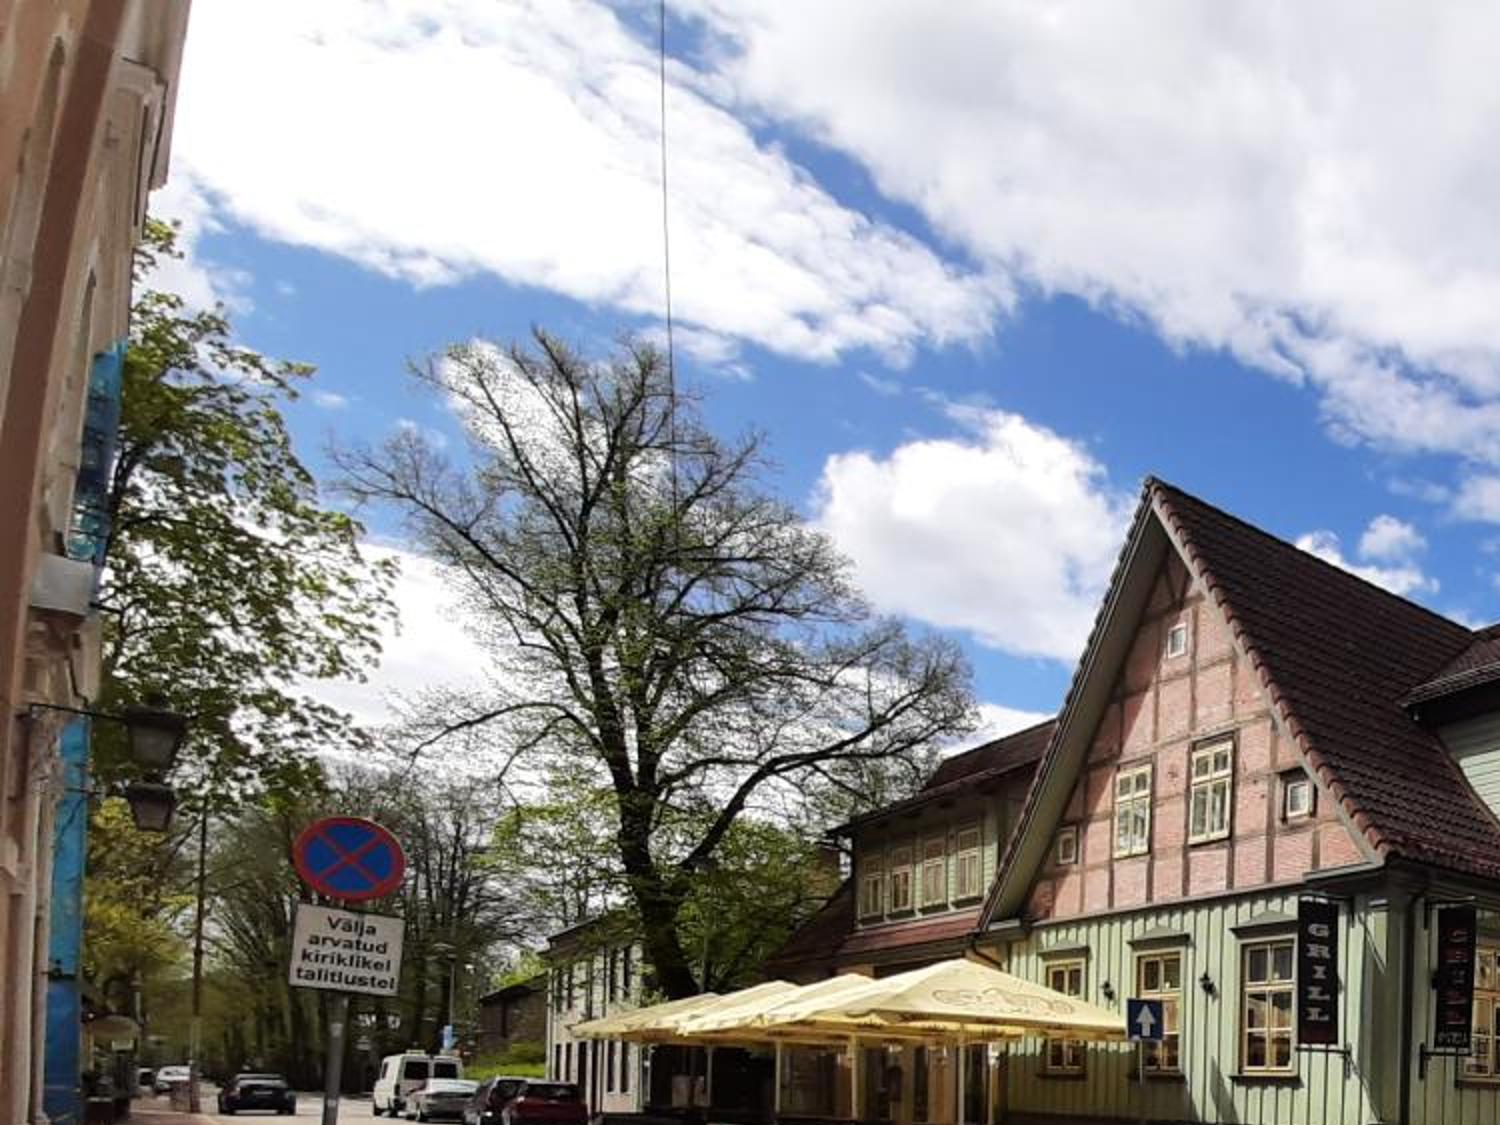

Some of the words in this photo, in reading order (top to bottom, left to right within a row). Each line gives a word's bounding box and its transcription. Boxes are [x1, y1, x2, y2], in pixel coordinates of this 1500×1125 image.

[327, 915, 377, 937] Välja
[308, 934, 388, 955] arvatud
[301, 948, 391, 972] kiriklikel
[1306, 923, 1331, 1021] GRILL
